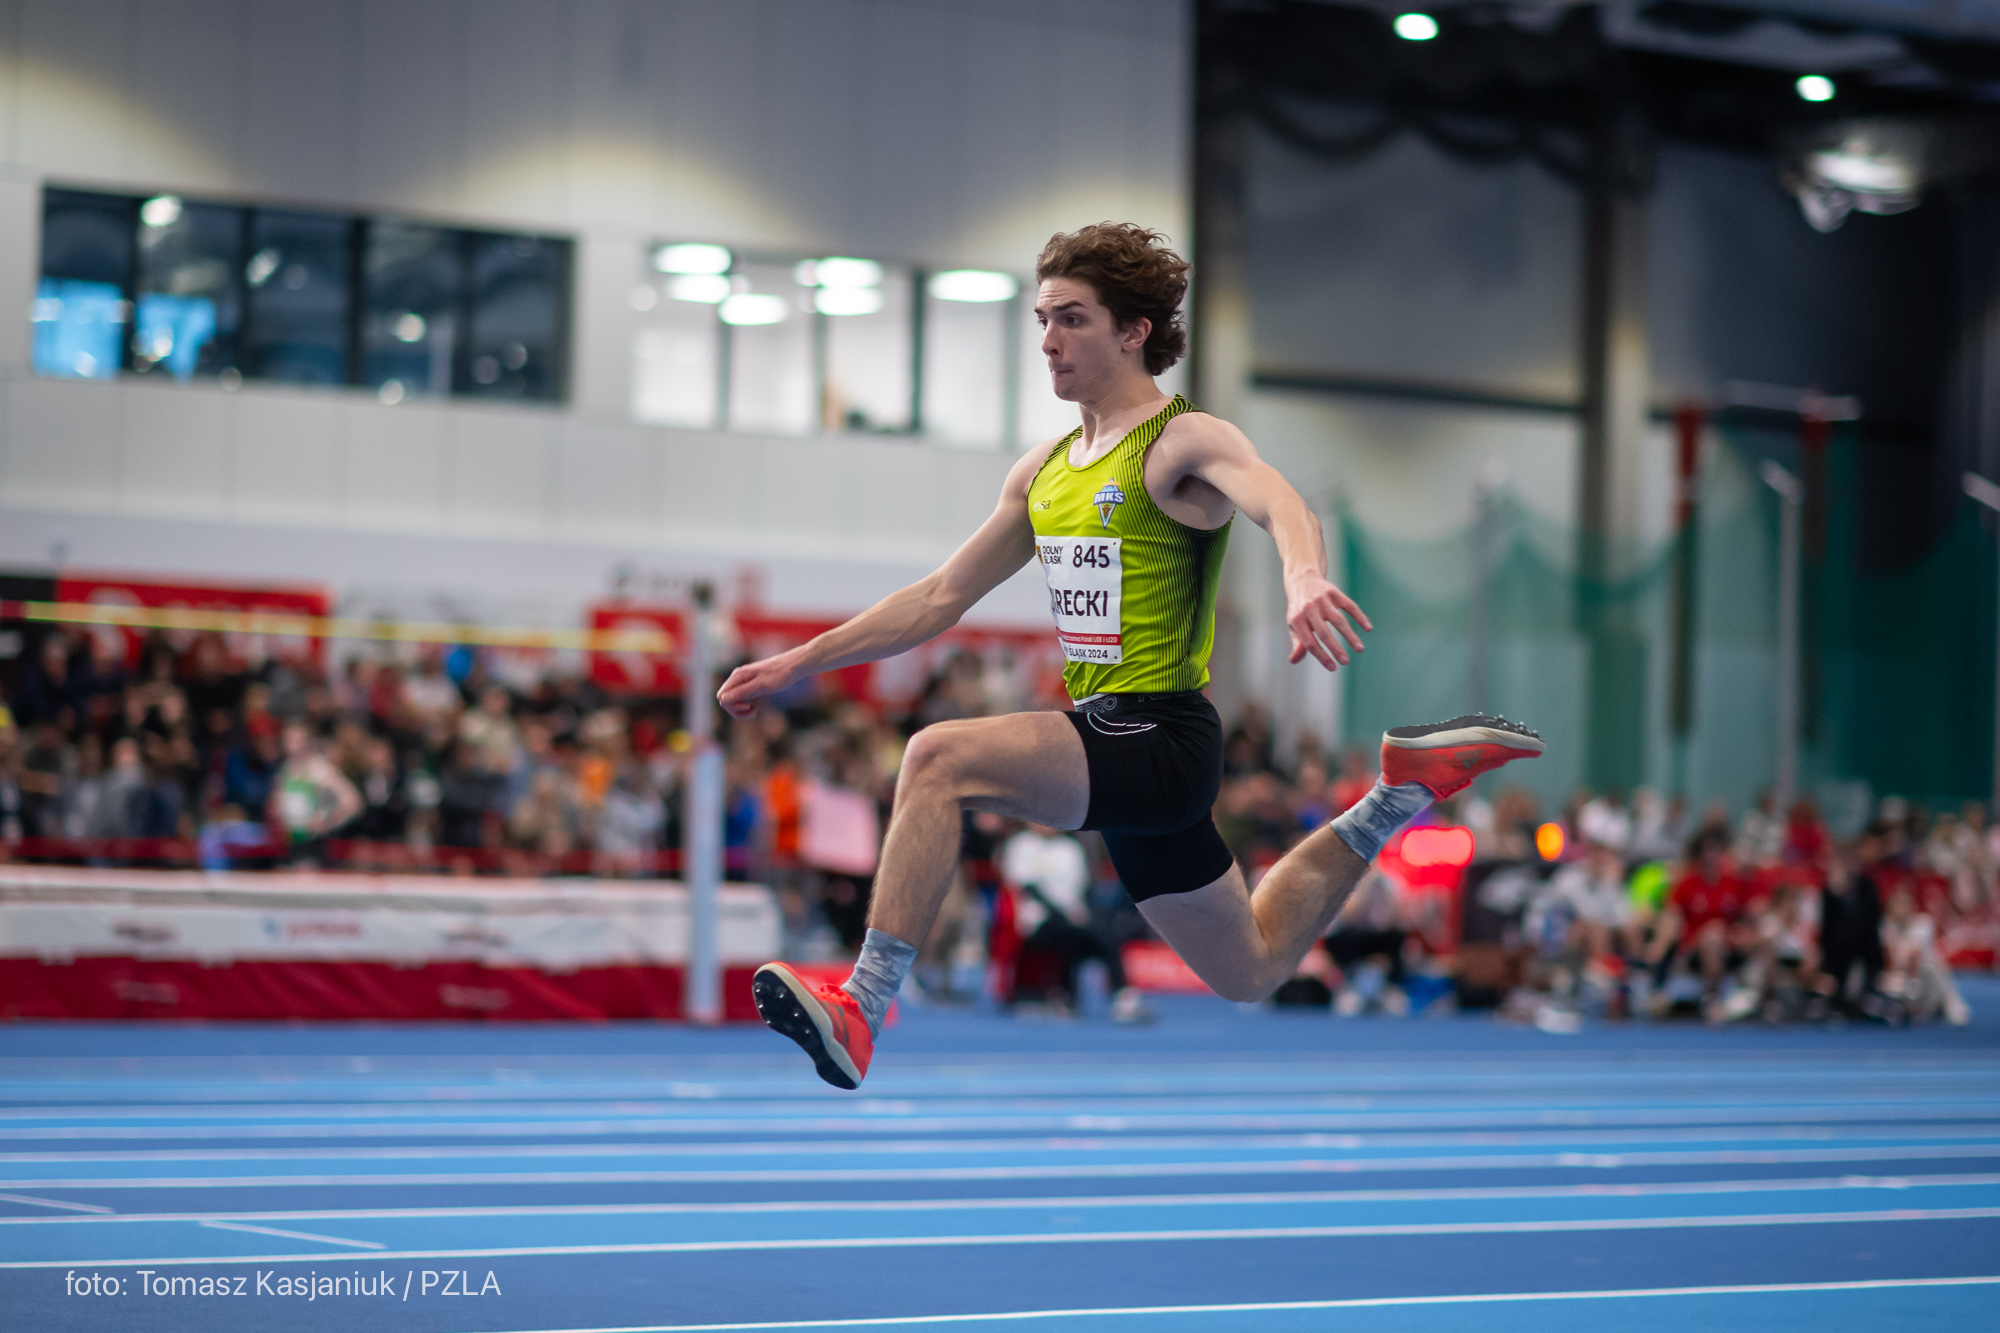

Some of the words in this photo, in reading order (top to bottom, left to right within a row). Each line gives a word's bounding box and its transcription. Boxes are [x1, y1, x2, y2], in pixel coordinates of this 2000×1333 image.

[1095, 492, 1124, 503] MKS
[1042, 545, 1063, 554] DOLNY
[1073, 545, 1110, 568] 845
[1088, 649, 1108, 658] 2024
